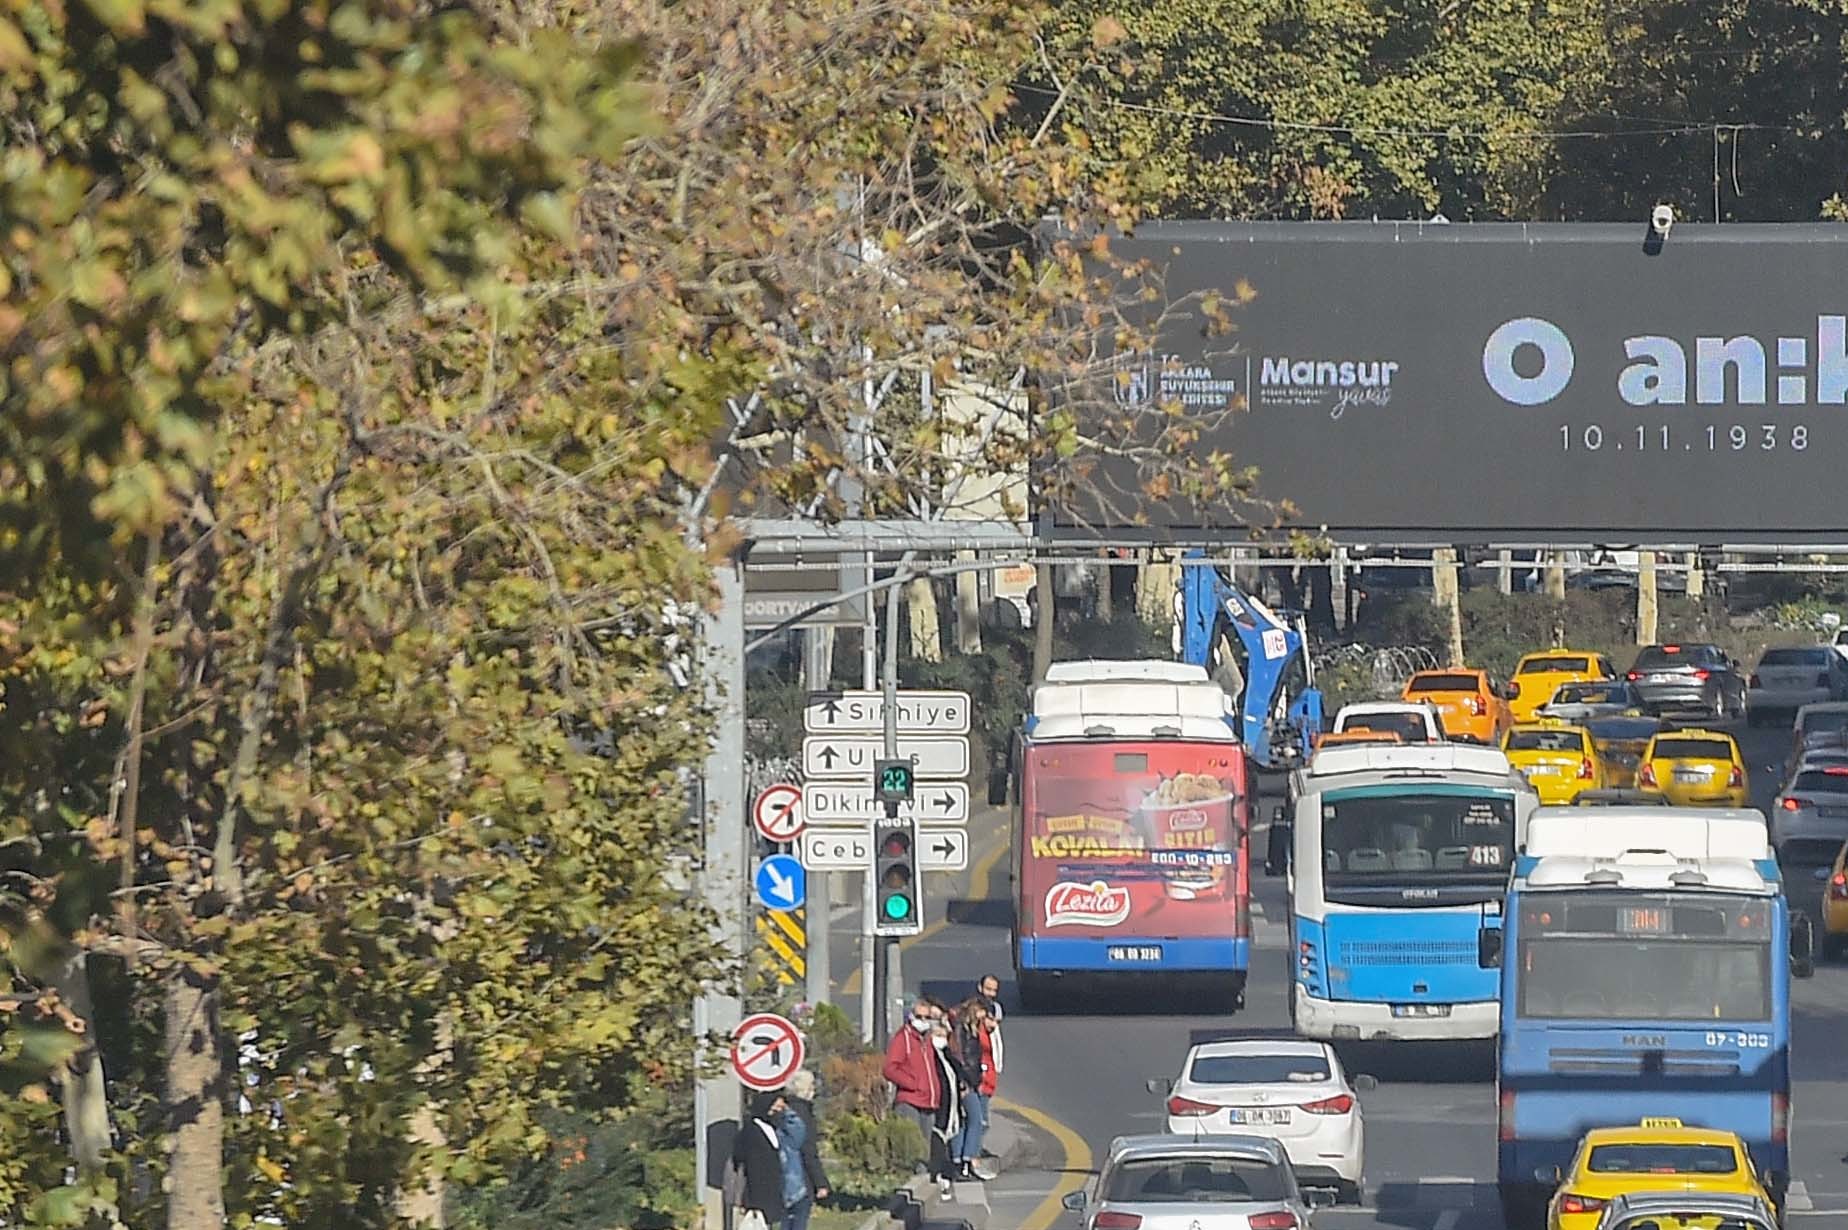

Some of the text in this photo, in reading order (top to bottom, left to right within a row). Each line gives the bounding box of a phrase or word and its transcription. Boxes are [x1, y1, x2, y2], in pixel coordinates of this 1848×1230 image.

[1482, 316, 1575, 405] O
[1261, 357, 1399, 386] Mansur
[1558, 425, 1810, 451] 10.11.1938
[848, 748, 921, 766] Uls
[882, 770, 907, 792] 22
[812, 841, 866, 858] Ceb
[1472, 846, 1500, 865] 413
[1622, 1034, 1666, 1047] MAN
